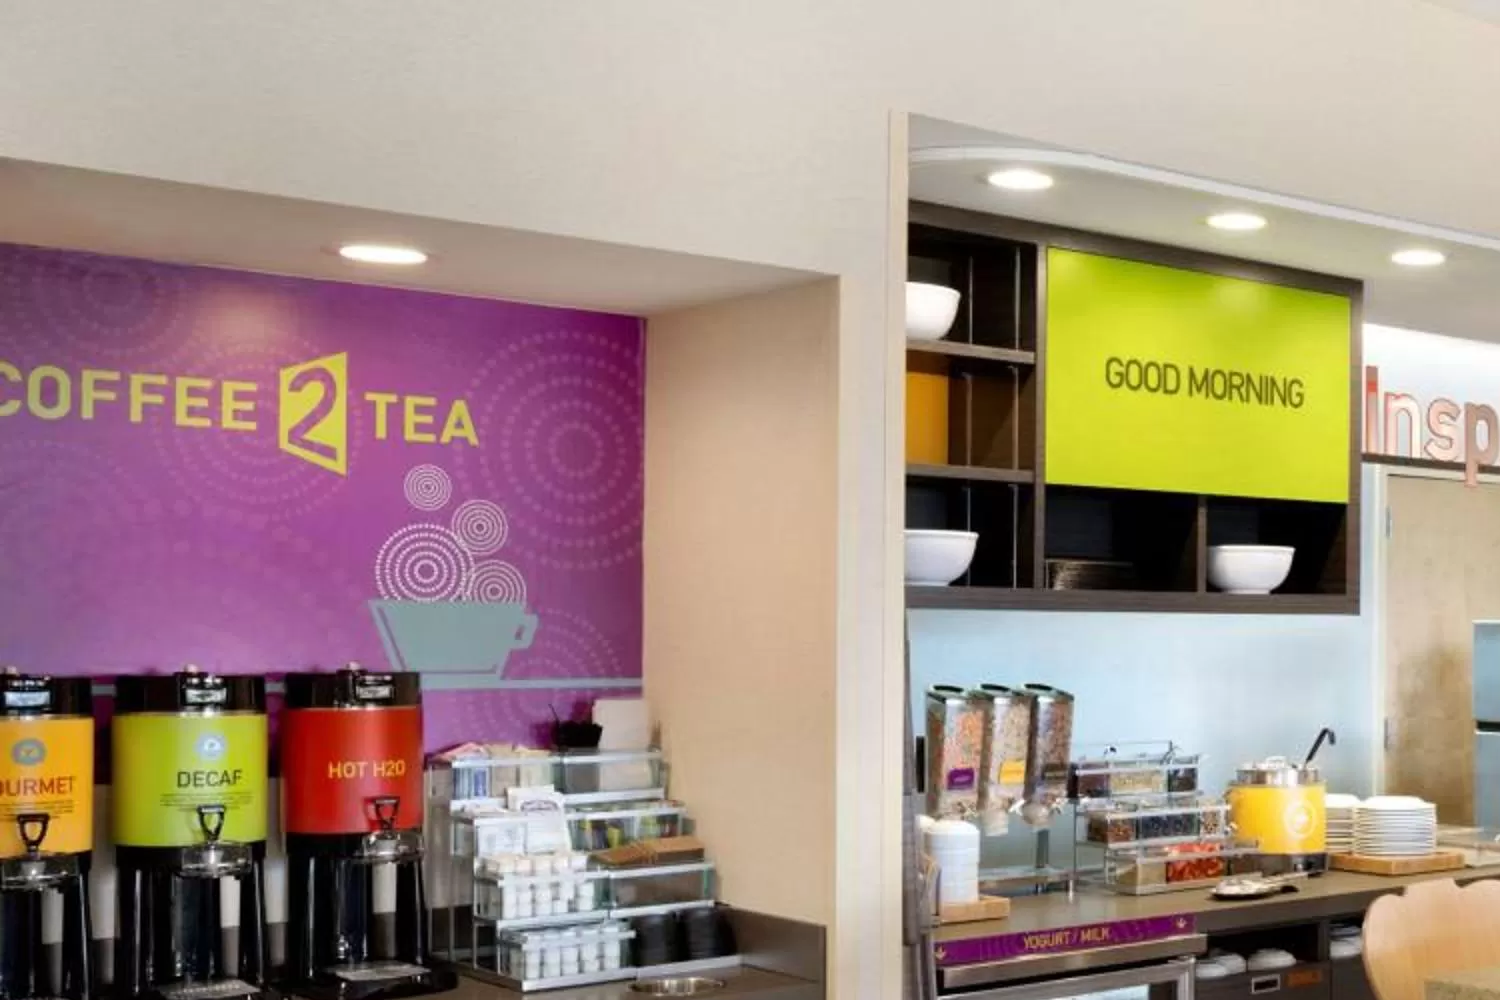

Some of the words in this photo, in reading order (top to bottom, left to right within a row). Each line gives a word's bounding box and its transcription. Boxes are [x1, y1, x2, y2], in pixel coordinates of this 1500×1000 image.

[1105, 356, 1181, 395] GOOD
[1187, 365, 1305, 409] MORNING
[287, 364, 340, 466] 2
[364, 391, 480, 447] TEA
[177, 769, 243, 788] DECAF
[327, 761, 368, 779] HOT
[1023, 931, 1071, 951] YOGURT
[1080, 926, 1109, 944] MILK
